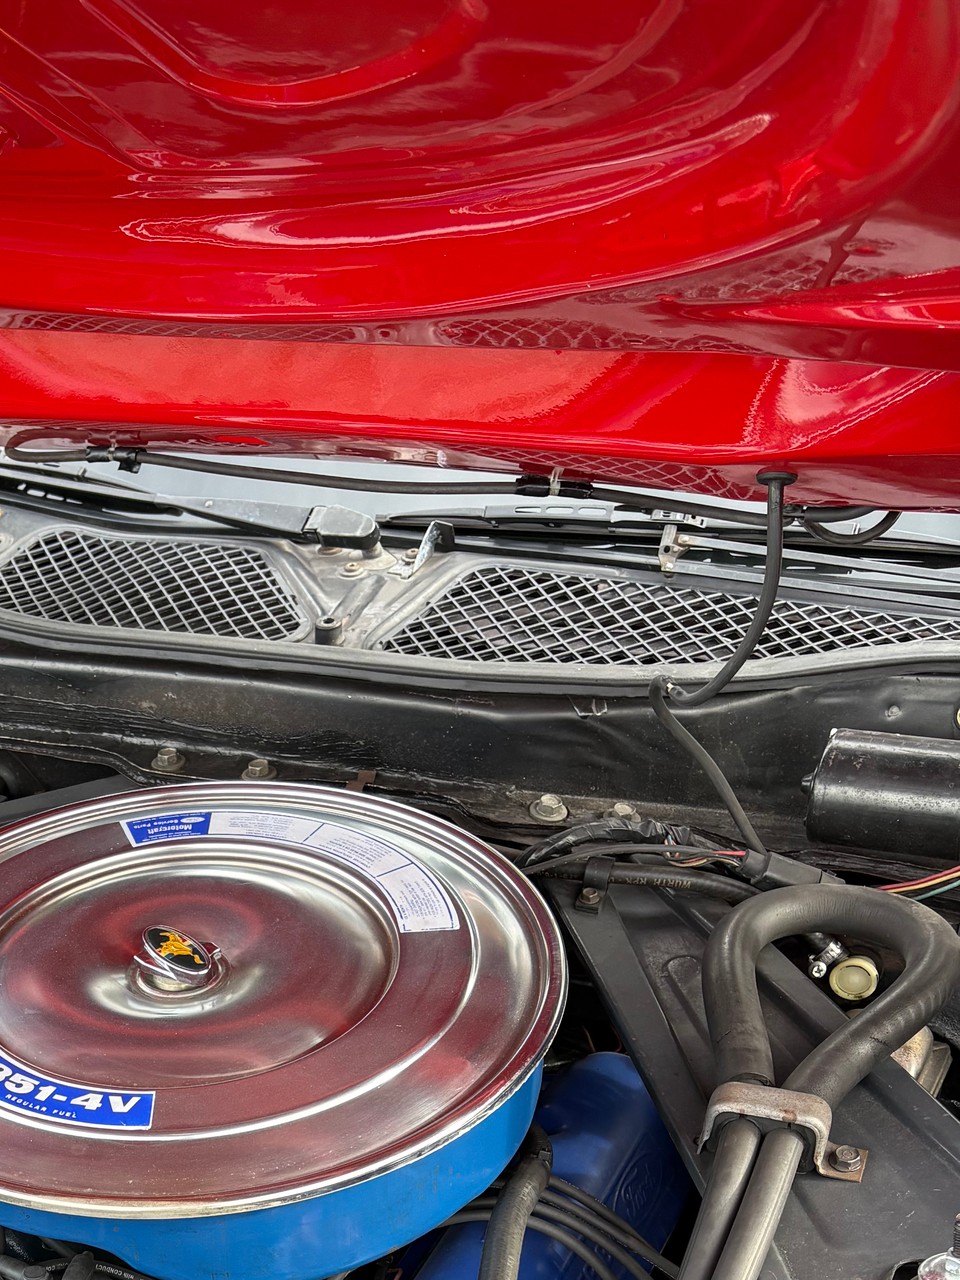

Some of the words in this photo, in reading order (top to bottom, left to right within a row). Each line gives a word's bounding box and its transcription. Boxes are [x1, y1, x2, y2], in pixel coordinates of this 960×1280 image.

[147, 824, 192, 835] Motorcraft
[5, 1093, 48, 1113] REGULAR
[52, 1108, 78, 1119] FUEL
